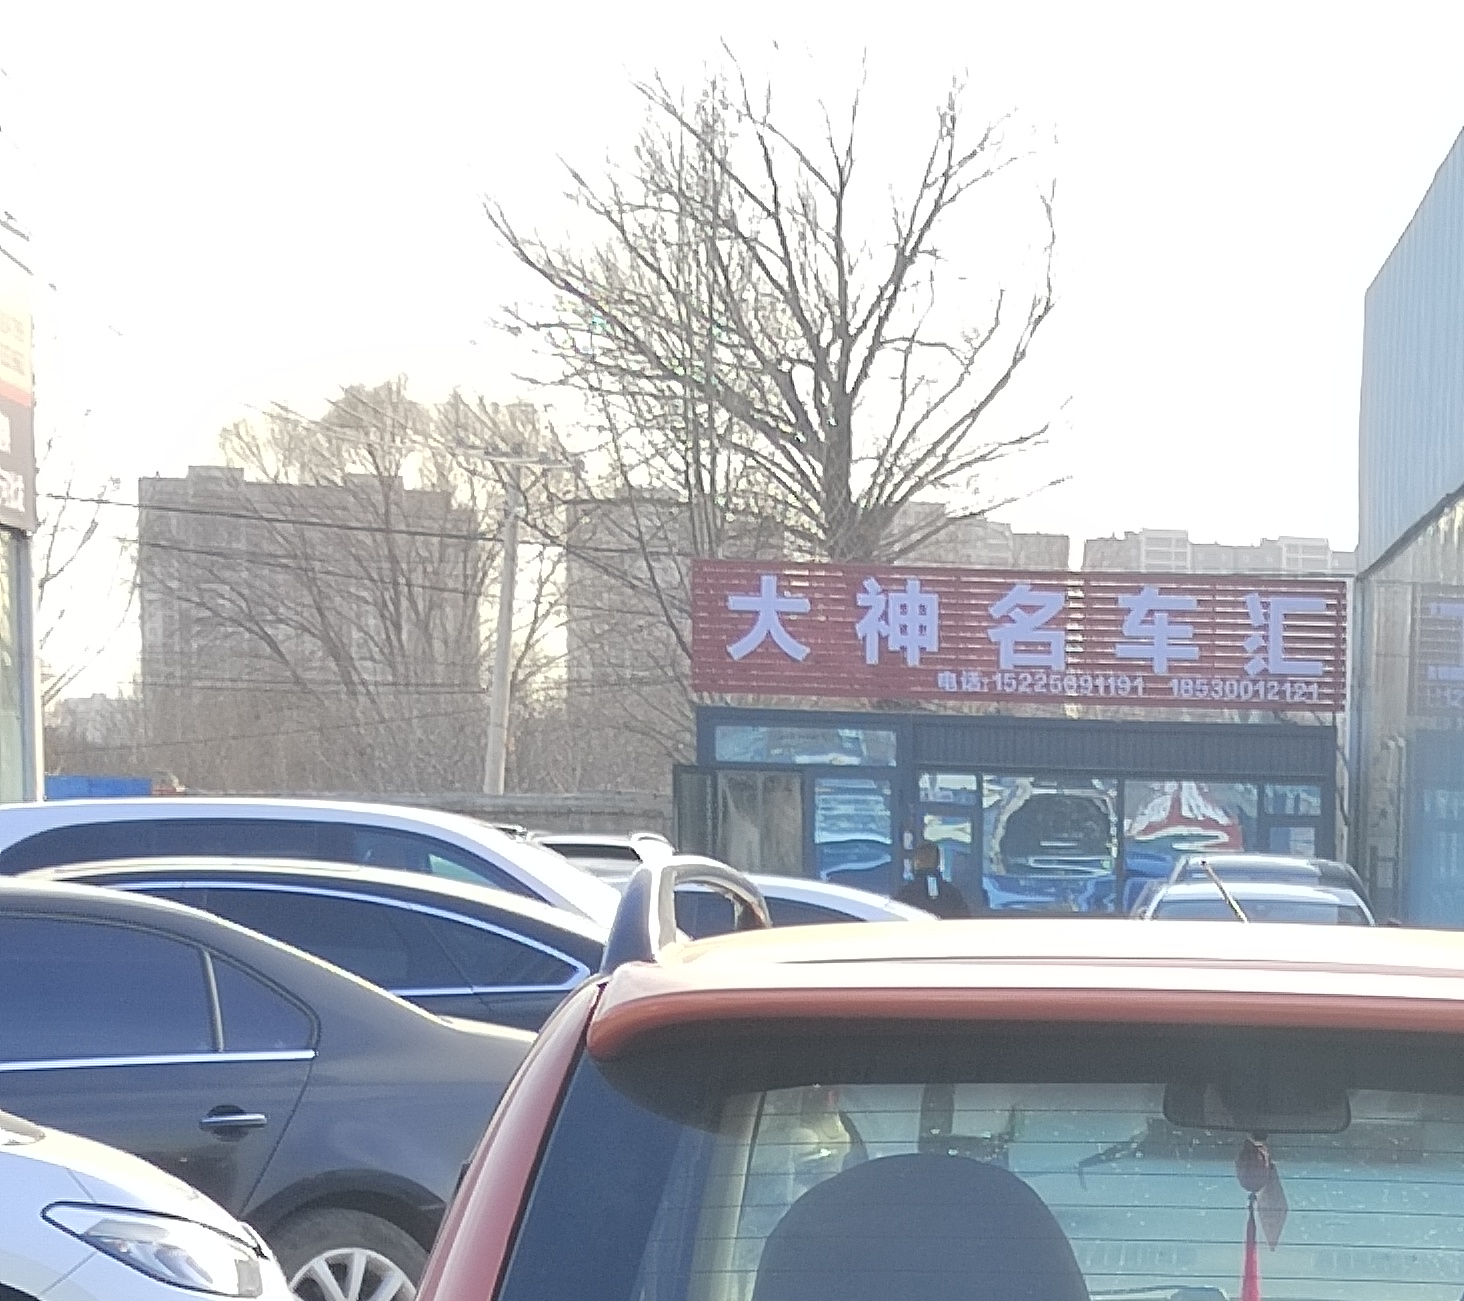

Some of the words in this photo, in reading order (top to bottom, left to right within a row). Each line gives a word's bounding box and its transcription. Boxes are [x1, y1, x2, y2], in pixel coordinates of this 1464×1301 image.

[727, 575, 1325, 676] 大神名车汇
